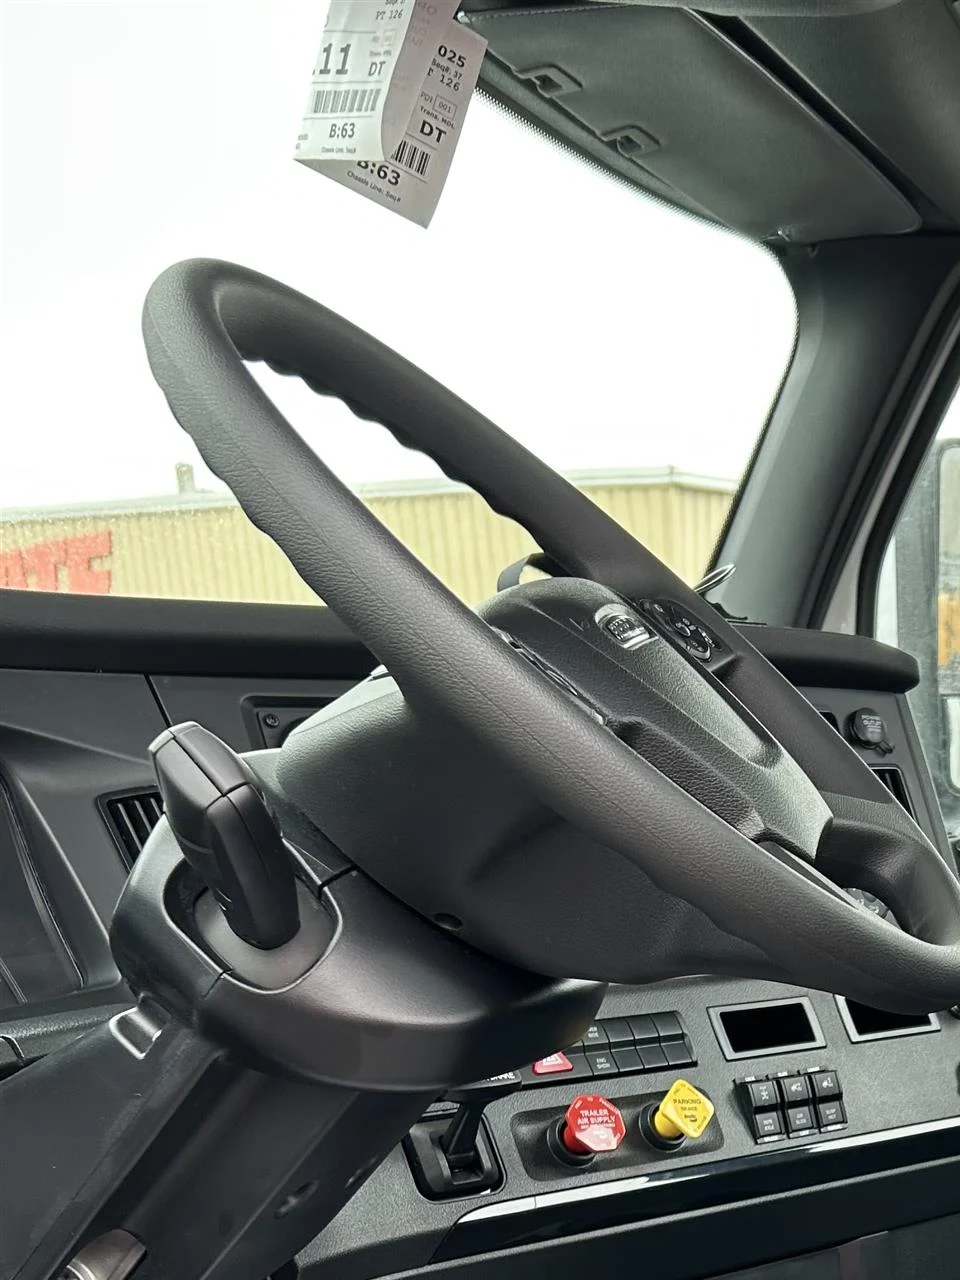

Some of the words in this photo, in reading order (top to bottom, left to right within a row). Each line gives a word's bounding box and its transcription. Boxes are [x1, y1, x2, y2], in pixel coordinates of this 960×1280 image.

[312, 43, 352, 75] 11
[438, 44, 467, 68] 025
[368, 61, 386, 76] DT
[440, 74, 461, 92] 126
[329, 122, 356, 138] B:63
[420, 120, 447, 144] DT
[580, 1108, 609, 1116] TRAILER
[590, 1115, 615, 1124] SUPPLY
